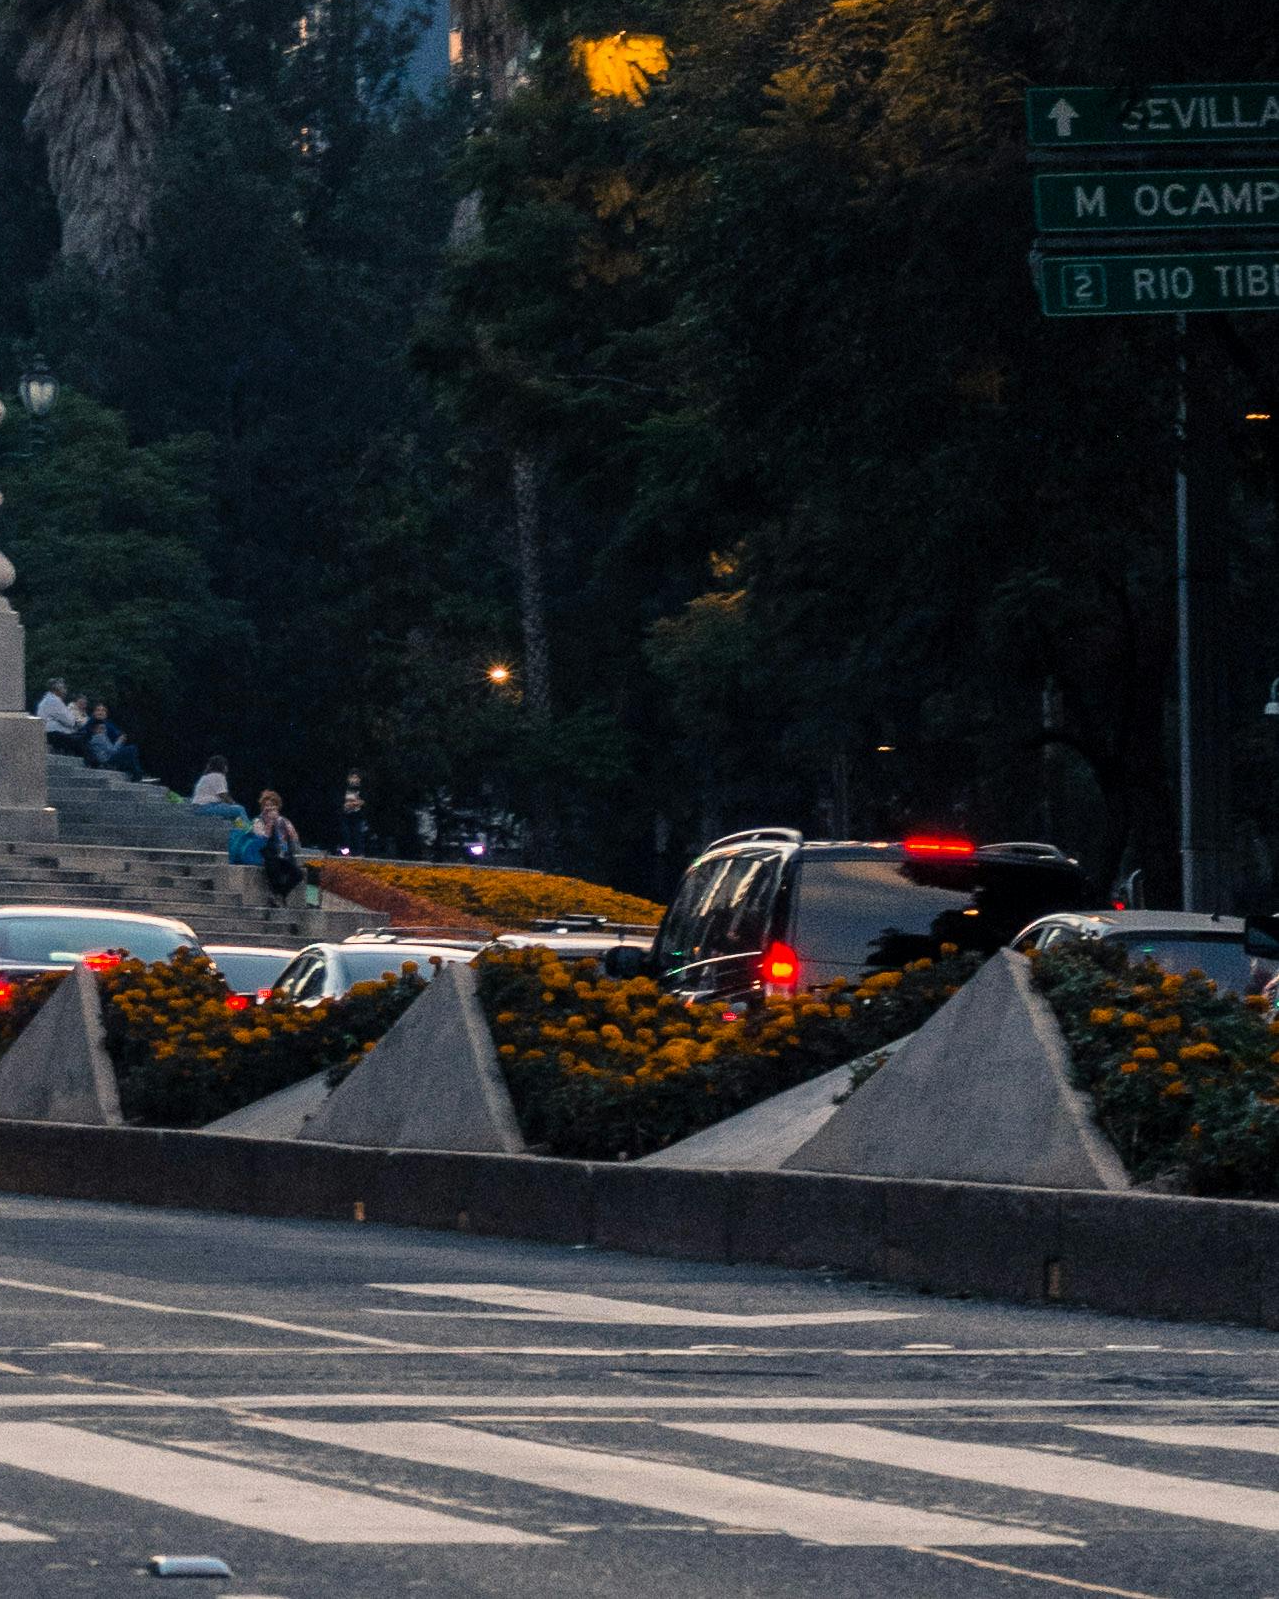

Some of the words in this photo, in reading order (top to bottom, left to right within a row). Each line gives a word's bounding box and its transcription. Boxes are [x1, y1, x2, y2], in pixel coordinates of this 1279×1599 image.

[1074, 185, 1107, 218] M
[1074, 274, 1094, 299] 2
[1133, 266, 1196, 301] RIO
